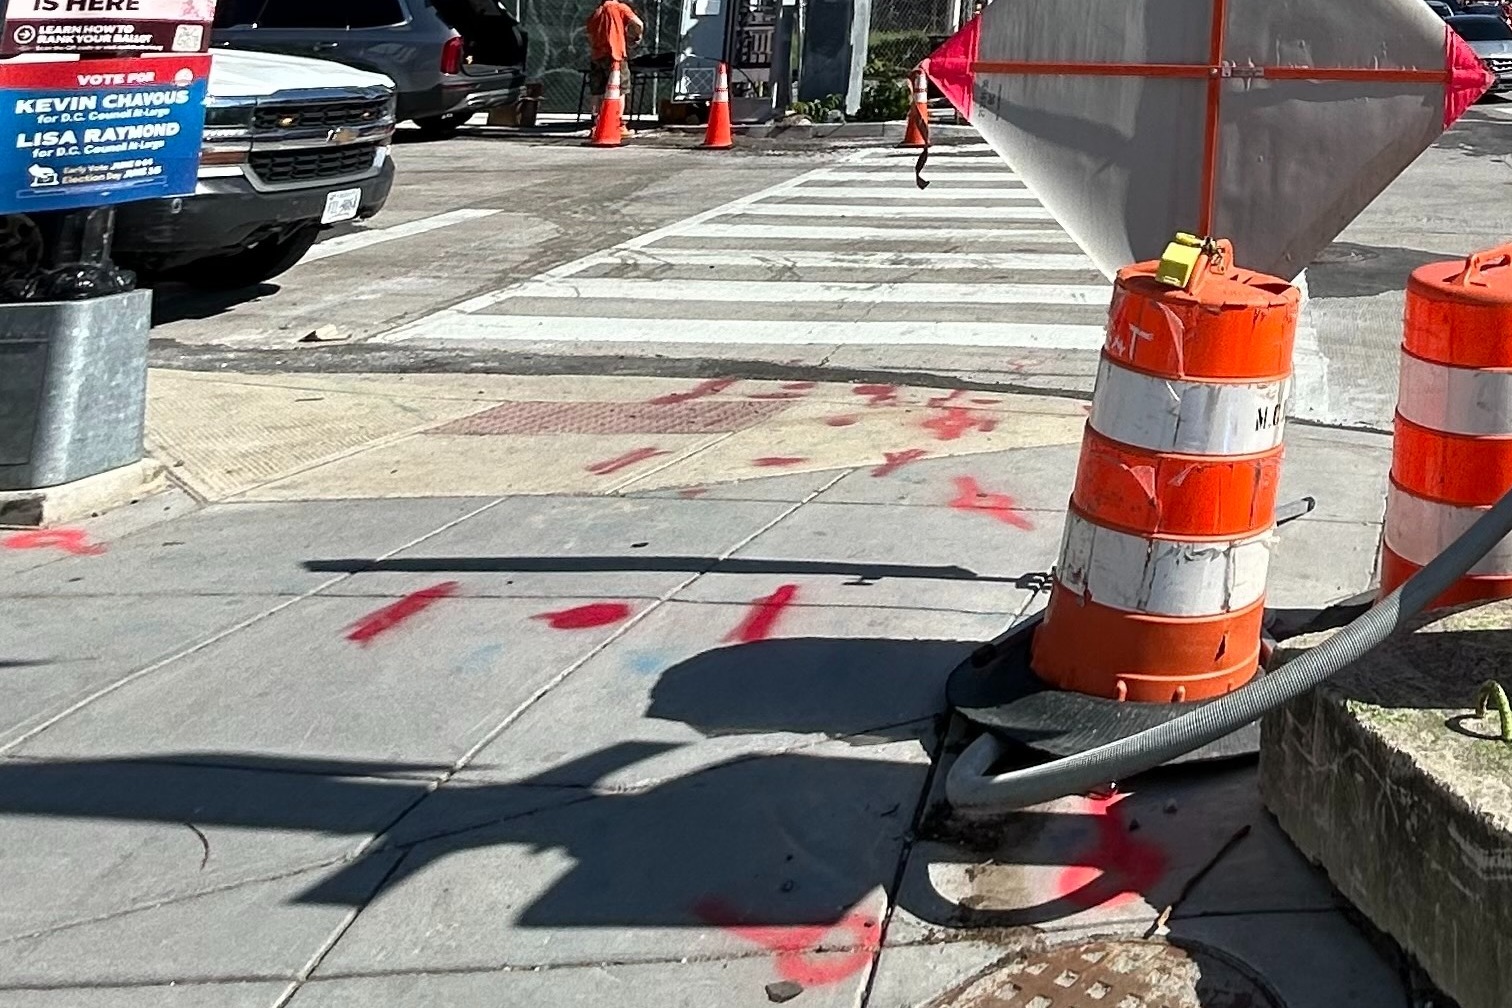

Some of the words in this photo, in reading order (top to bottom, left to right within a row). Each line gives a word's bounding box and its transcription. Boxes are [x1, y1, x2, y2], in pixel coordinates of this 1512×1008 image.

[39, 25, 82, 35] LEARN
[83, 25, 116, 34] HOW
[116, 25, 135, 34] TO
[36, 34, 74, 44] RANK
[76, 34, 112, 44] YOUR
[113, 34, 153, 44] BALLOT
[77, 73, 125, 86] VOTE
[127, 72, 156, 84] FOR
[15, 95, 97, 114] KEVIN
[102, 90, 190, 109] CHAVOUS
[37, 114, 58, 125] for
[60, 112, 86, 123] D.C.
[88, 109, 131, 122] Council
[16, 130, 77, 148] LISA
[84, 122, 181, 143] RAYMOND
[32, 148, 53, 158] for
[56, 146, 81, 157] D.C.
[83, 143, 127, 156] Council
